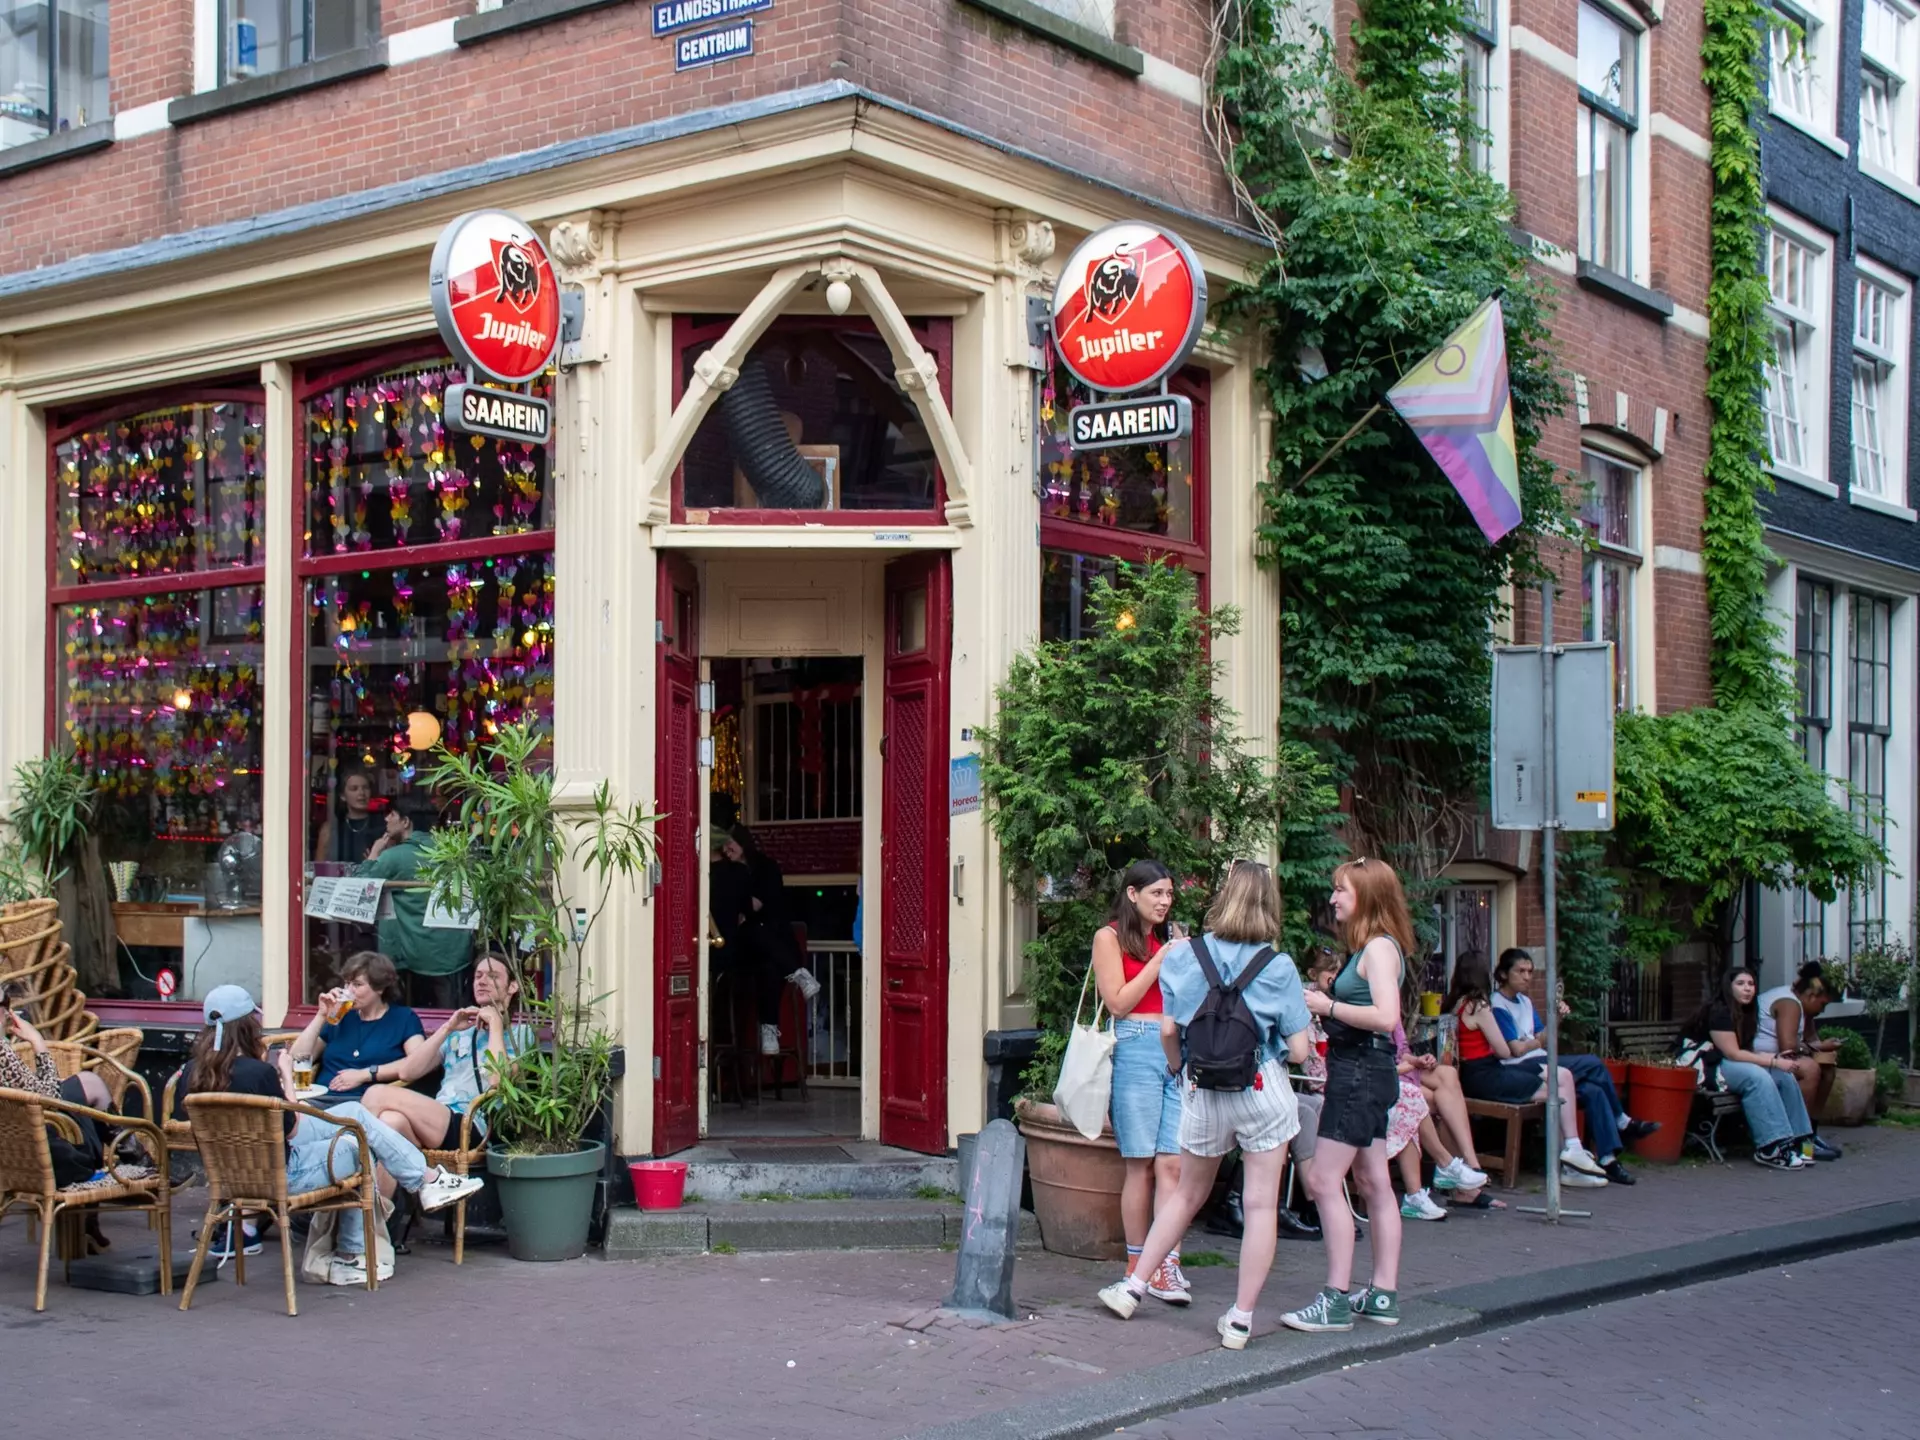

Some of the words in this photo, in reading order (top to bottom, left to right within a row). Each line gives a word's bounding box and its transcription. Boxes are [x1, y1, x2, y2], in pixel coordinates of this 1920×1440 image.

[681, 27, 747, 62] CENTRUM
[473, 312, 547, 351] Jupiler
[1076, 328, 1163, 363] Jupiler
[464, 394, 545, 434] SAAREIN
[1077, 404, 1176, 440] SAAREIN
[952, 795, 978, 808] Horeca
